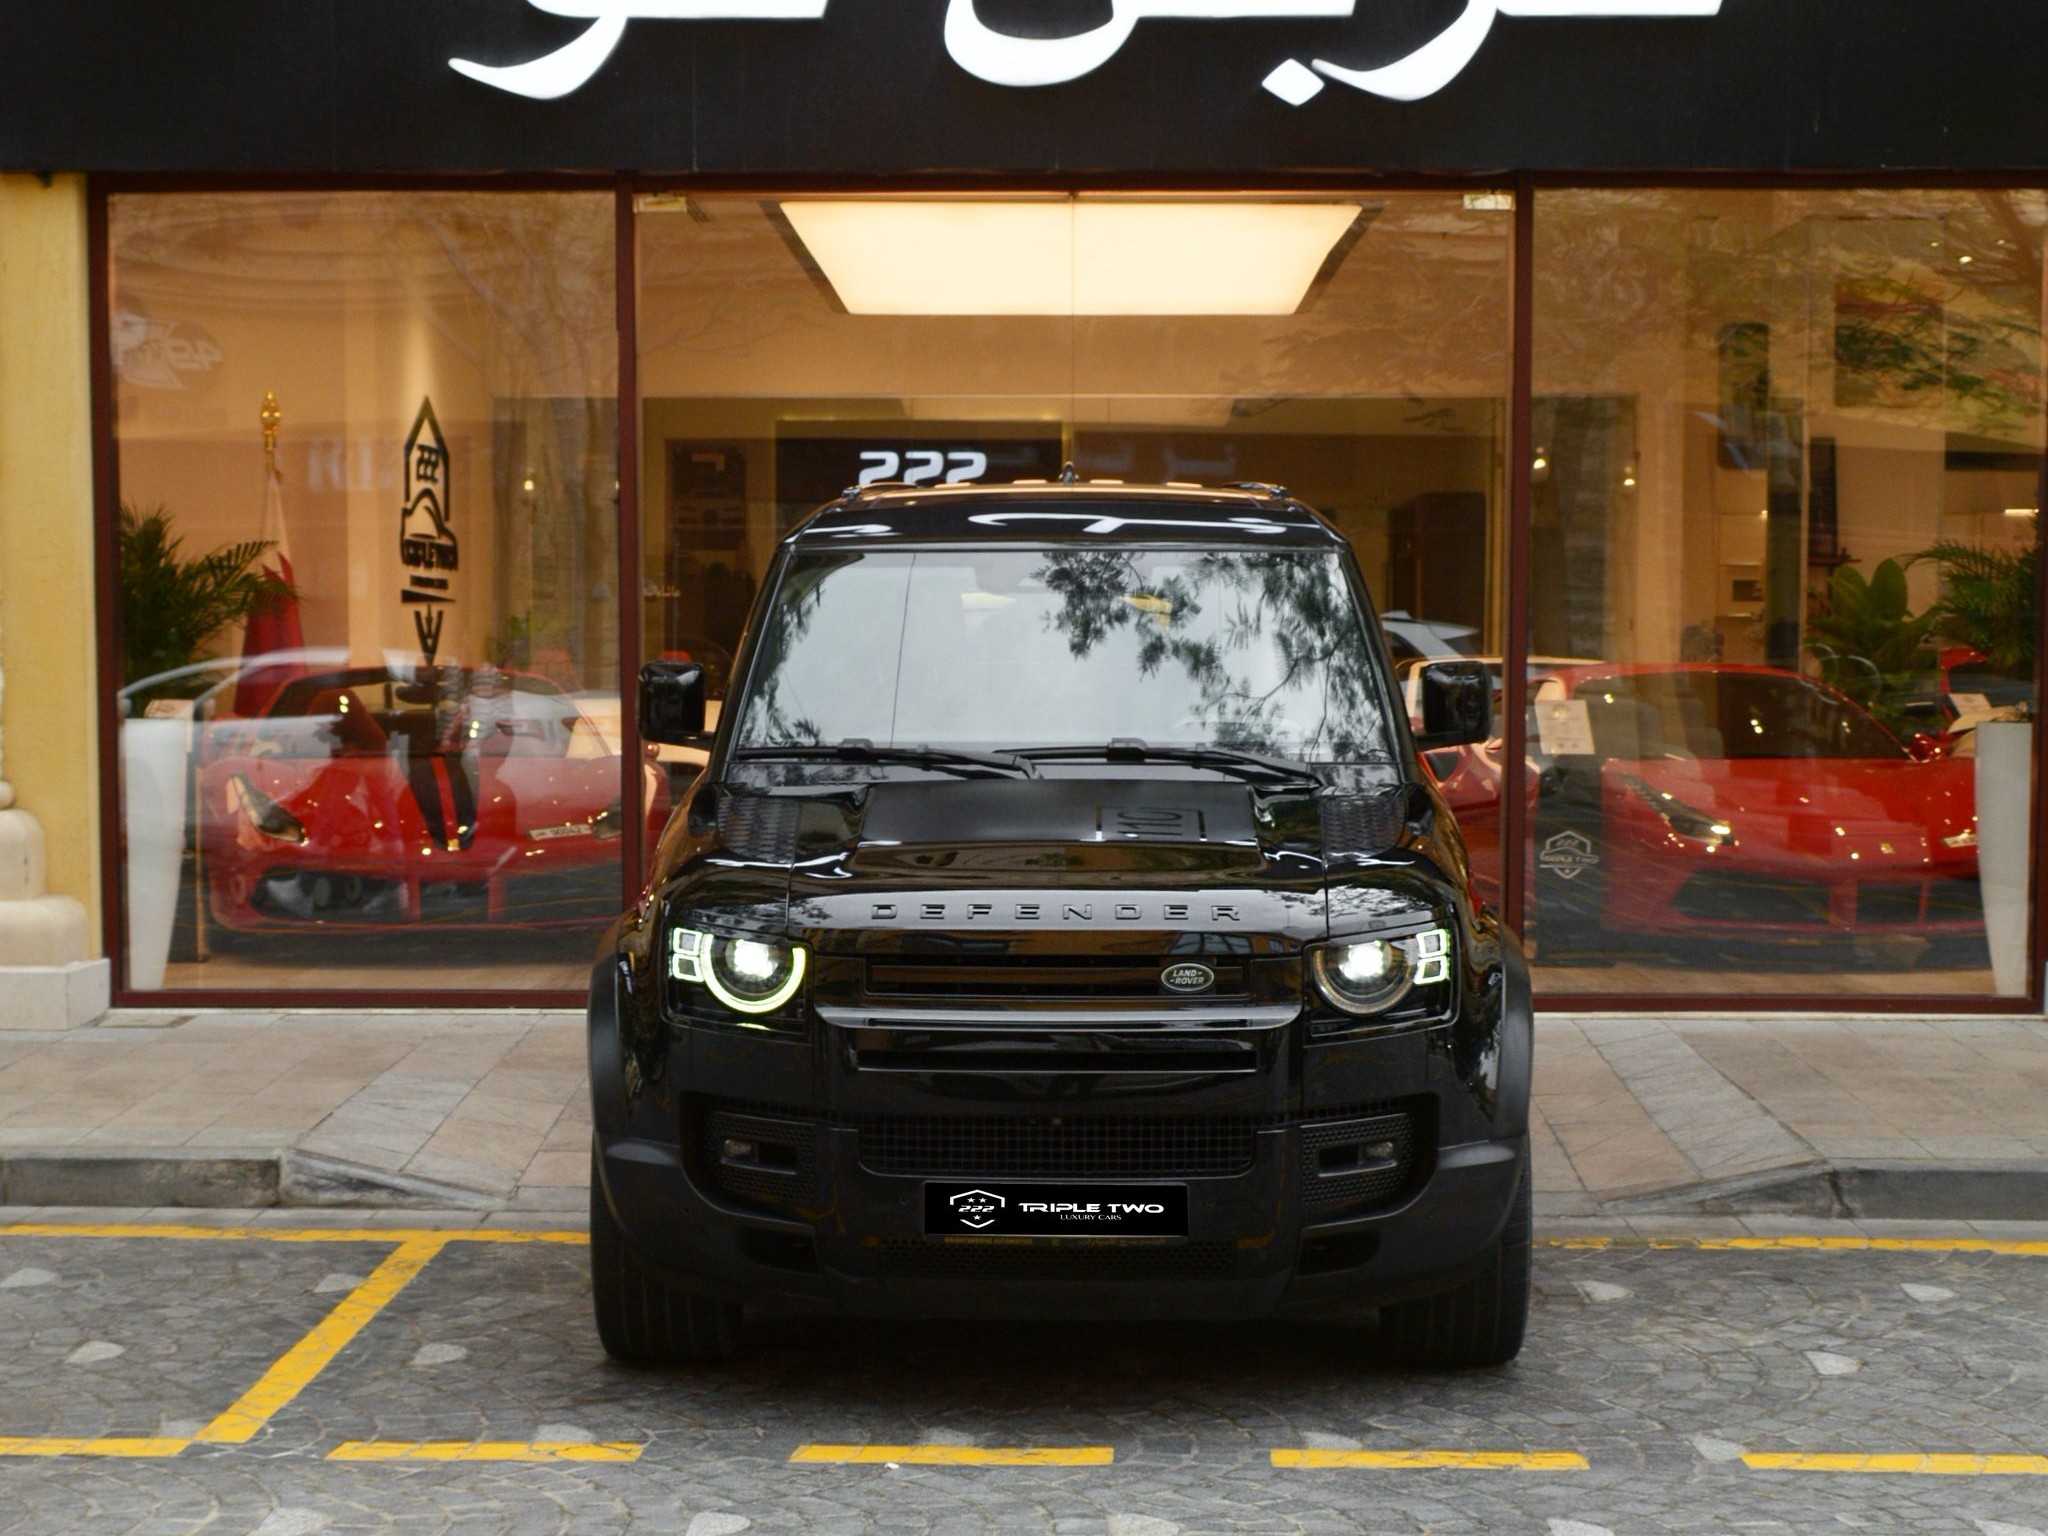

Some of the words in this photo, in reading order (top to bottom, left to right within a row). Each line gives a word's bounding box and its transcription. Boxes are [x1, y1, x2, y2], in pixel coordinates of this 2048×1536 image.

[871, 903, 1241, 921] DEFENDER
[958, 1205, 995, 1213] 222
[1018, 1203, 1101, 1213] TRIPLE
[1107, 1203, 1165, 1214] TWO
